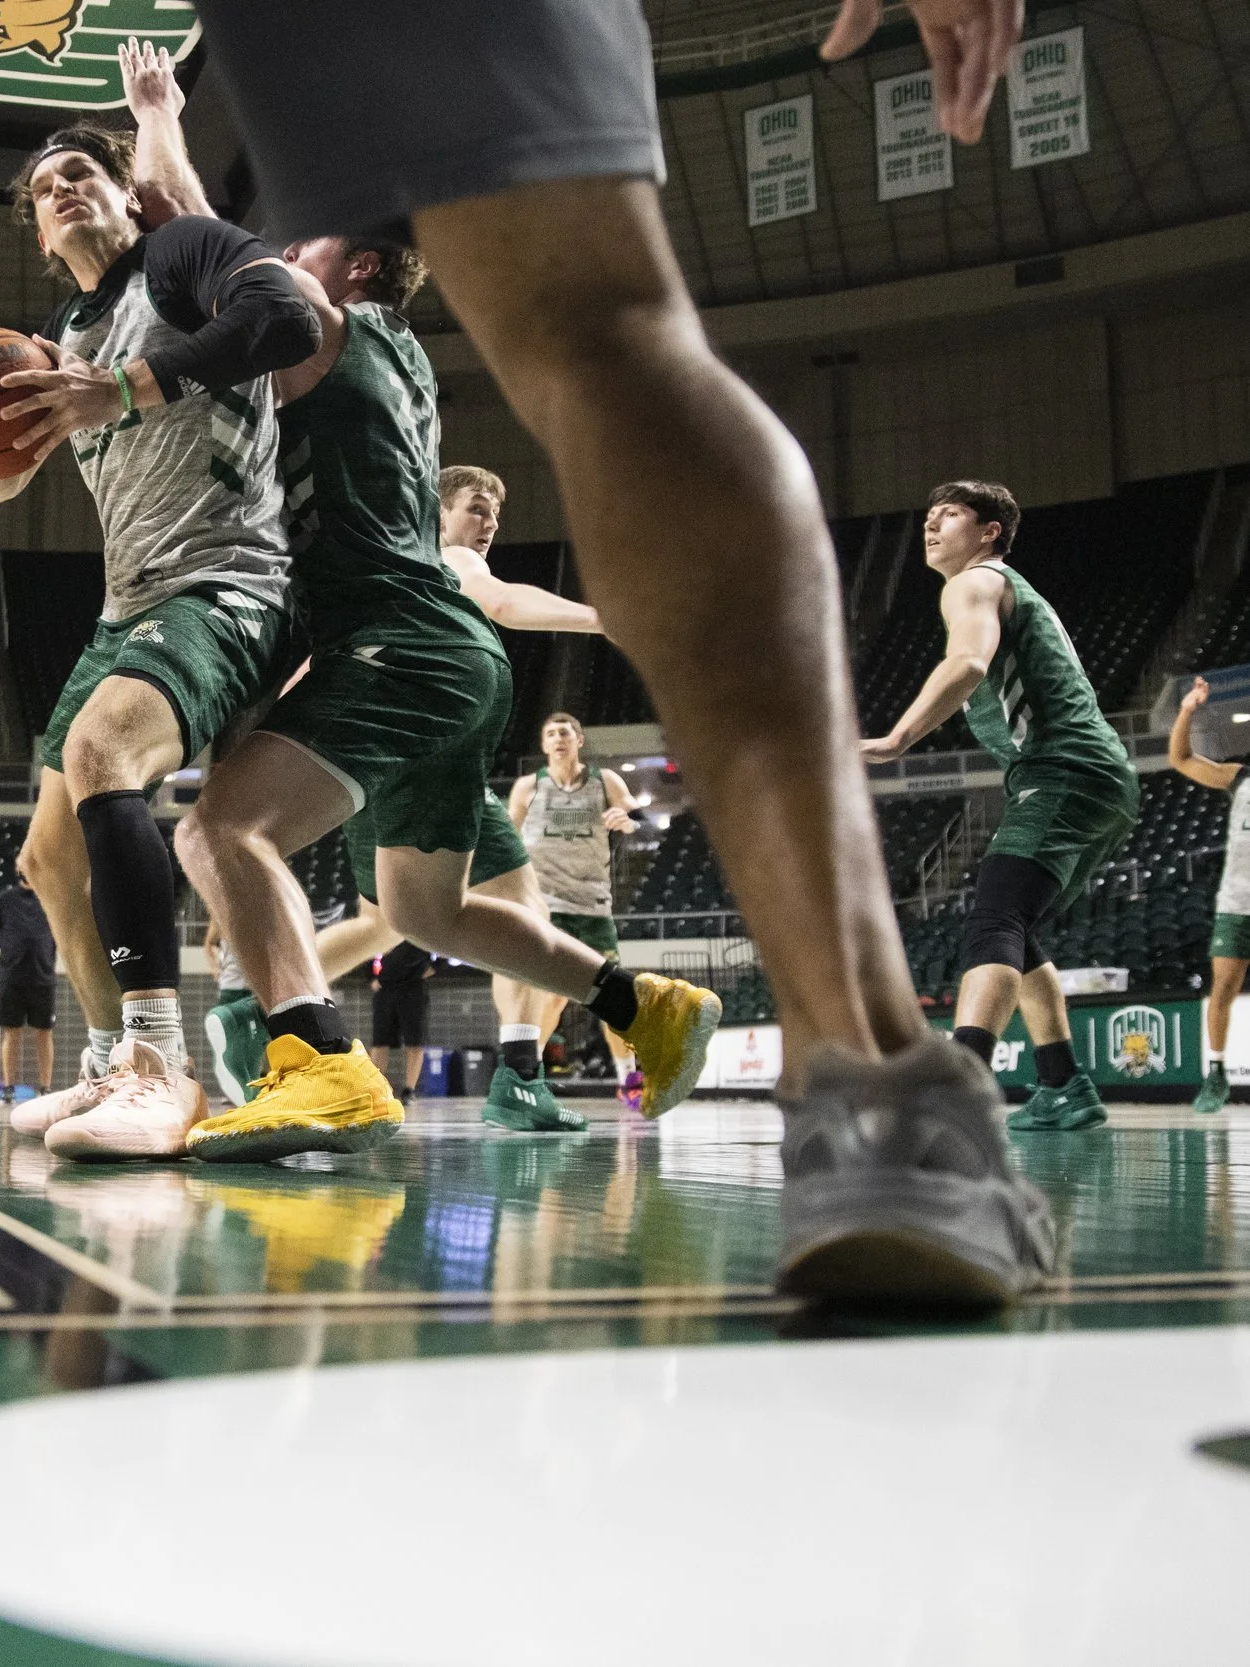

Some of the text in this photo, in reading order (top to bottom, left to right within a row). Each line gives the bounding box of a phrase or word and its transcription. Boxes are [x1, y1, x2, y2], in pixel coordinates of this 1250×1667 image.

[1024, 43, 1065, 72] OHIO
[892, 81, 931, 108] OHIO
[760, 107, 797, 136] OHIO
[1019, 119, 1059, 138] SWEET
[1029, 134, 1071, 158] 2005
